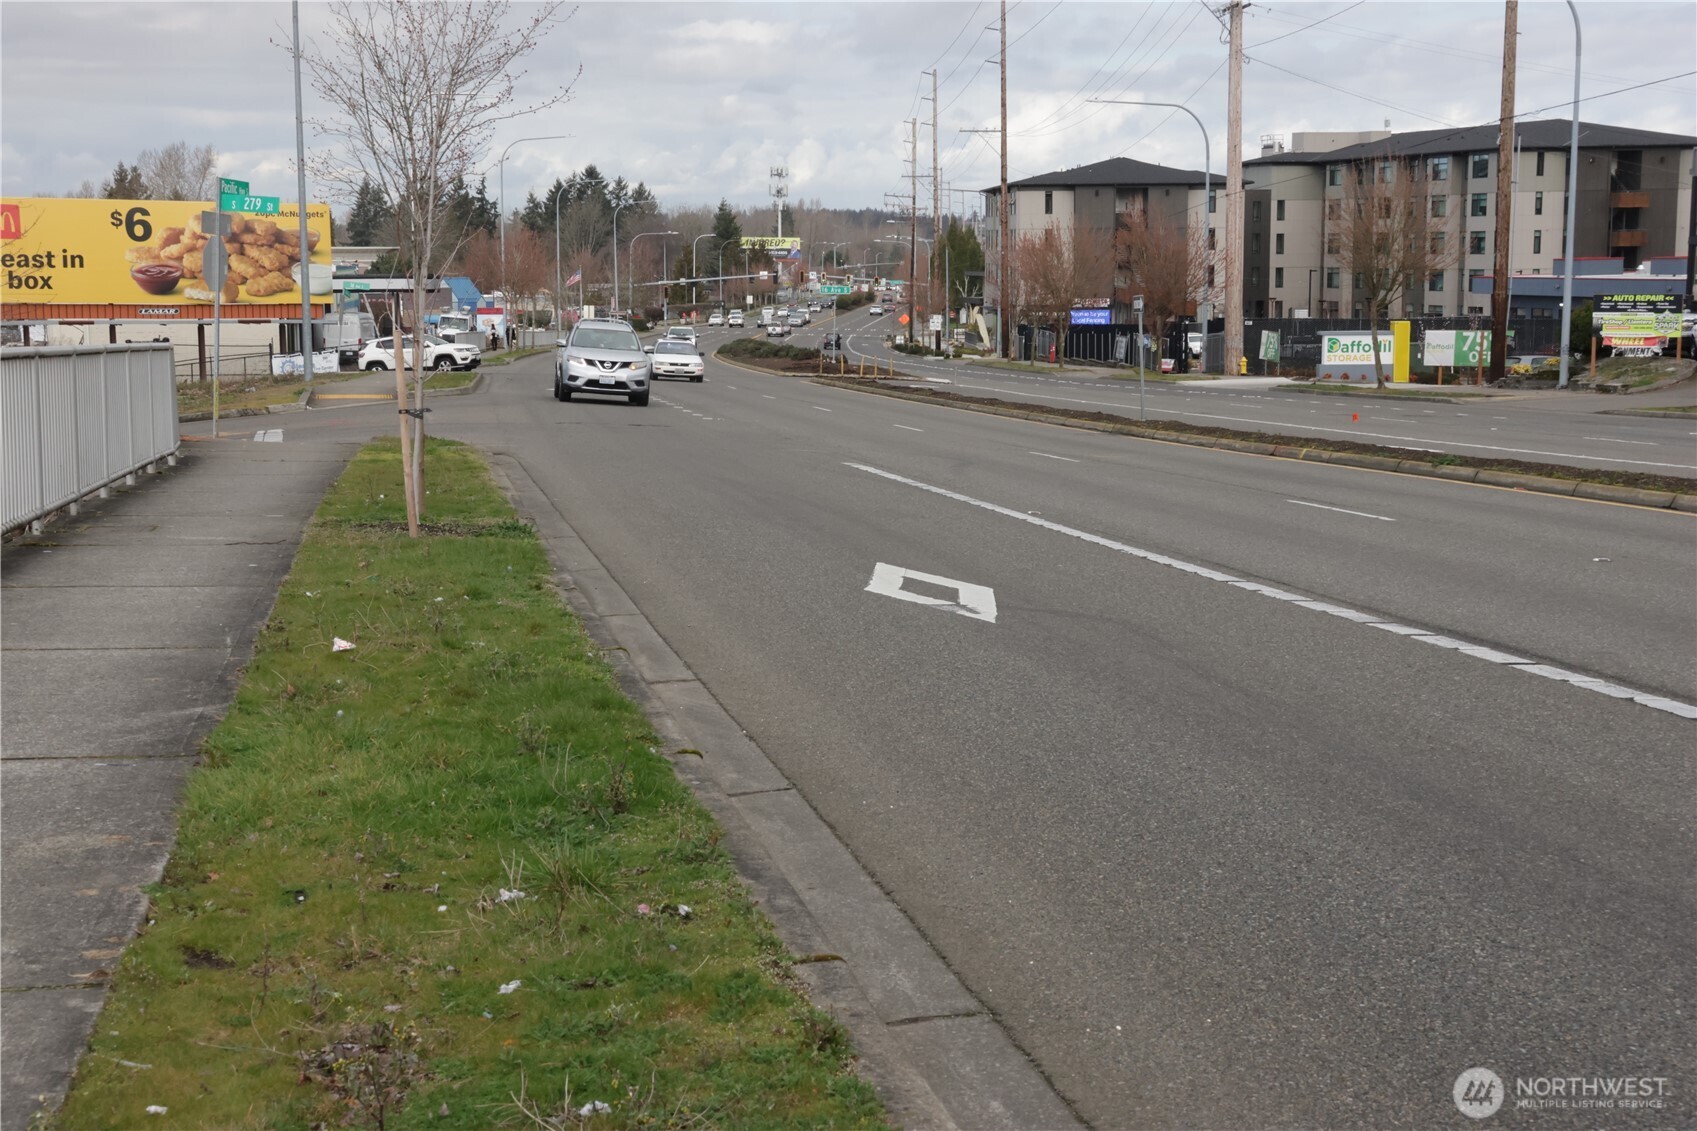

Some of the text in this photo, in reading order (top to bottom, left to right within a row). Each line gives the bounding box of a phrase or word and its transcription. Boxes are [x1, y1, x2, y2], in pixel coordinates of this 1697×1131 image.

[221, 180, 238, 194] Pacific
[231, 197, 273, 211] S 279 St
[110, 206, 153, 243] $6
[62, 248, 84, 268] in
[8, 270, 53, 290] box
[1655, 322, 1679, 331] SPARK
[1462, 331, 1492, 351] 75
[1611, 337, 1645, 345] WHEEL
[1327, 354, 1372, 362] STORAGE
